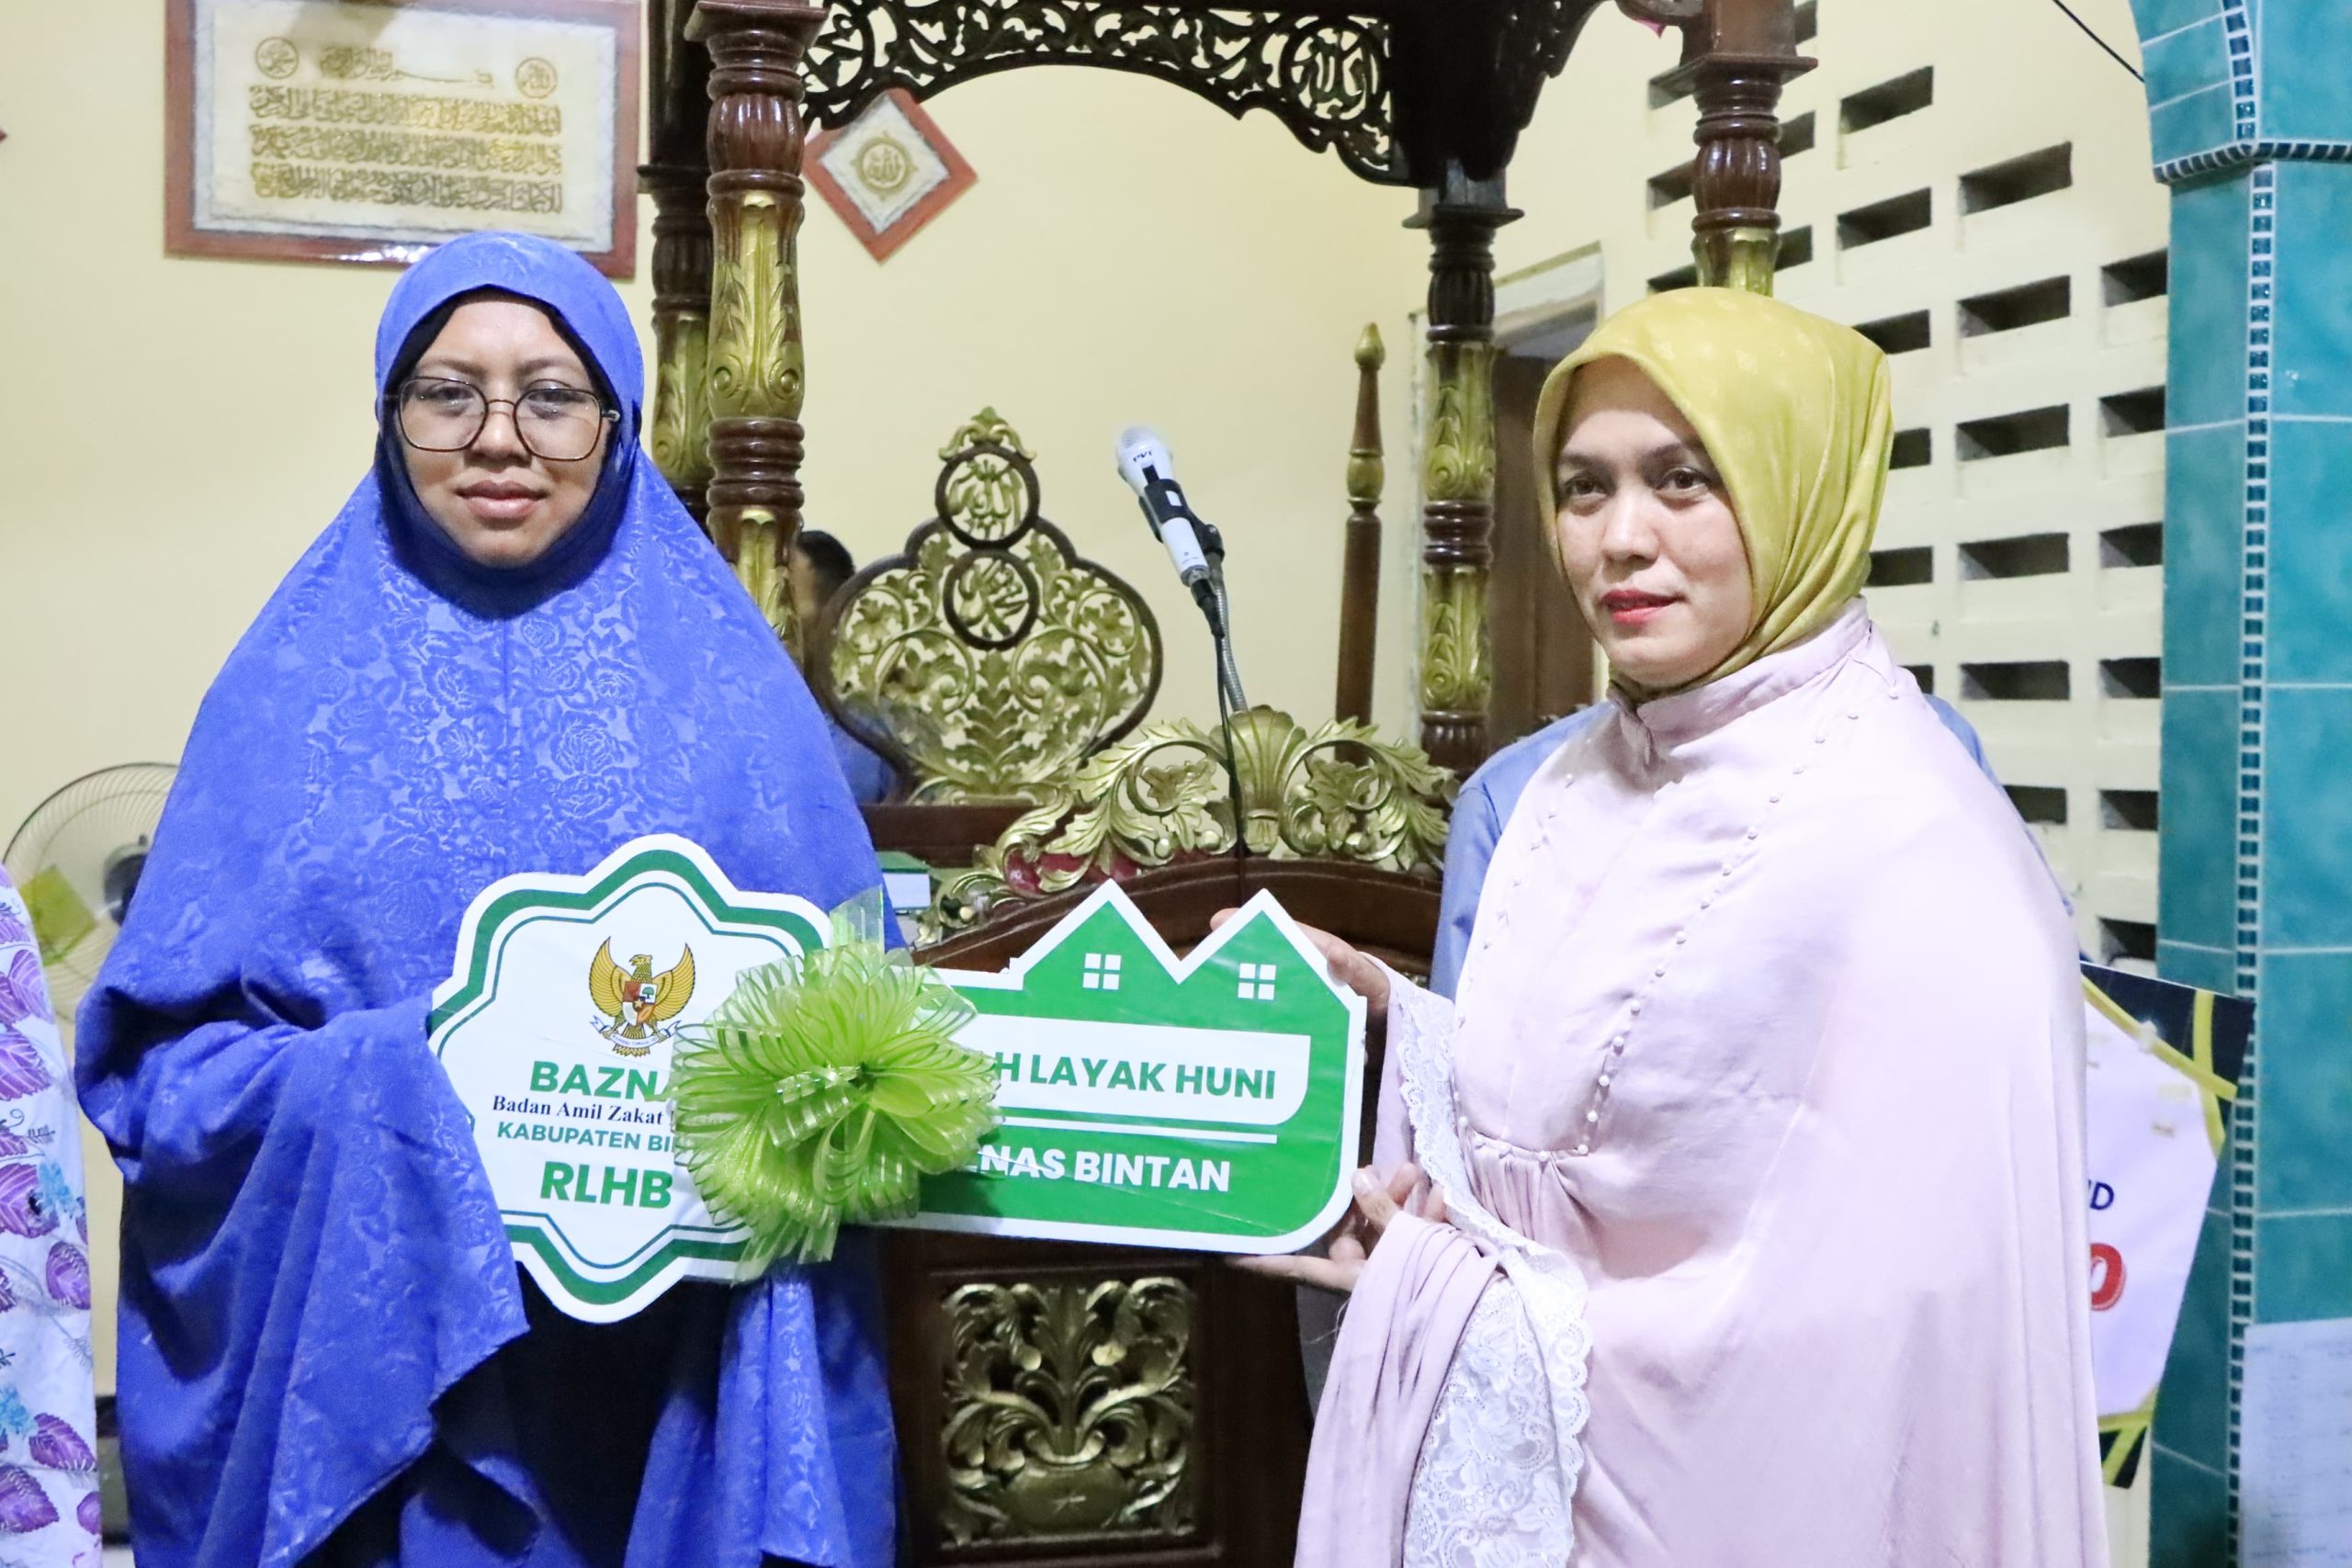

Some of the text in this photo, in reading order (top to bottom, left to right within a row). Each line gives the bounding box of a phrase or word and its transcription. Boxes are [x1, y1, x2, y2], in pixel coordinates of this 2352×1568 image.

[529, 1060, 670, 1100] BAZN
[1030, 1055, 1166, 1092] LAYAK
[1175, 1065, 1276, 1100] HUNI
[492, 1095, 551, 1115] Badan
[556, 1100, 602, 1120] Amil
[607, 1105, 663, 1125] Zakat
[497, 1122, 675, 1153] KABUPATEN BI
[540, 1161, 673, 1209] RLHB
[979, 1144, 1231, 1193] NAS BINTAN
